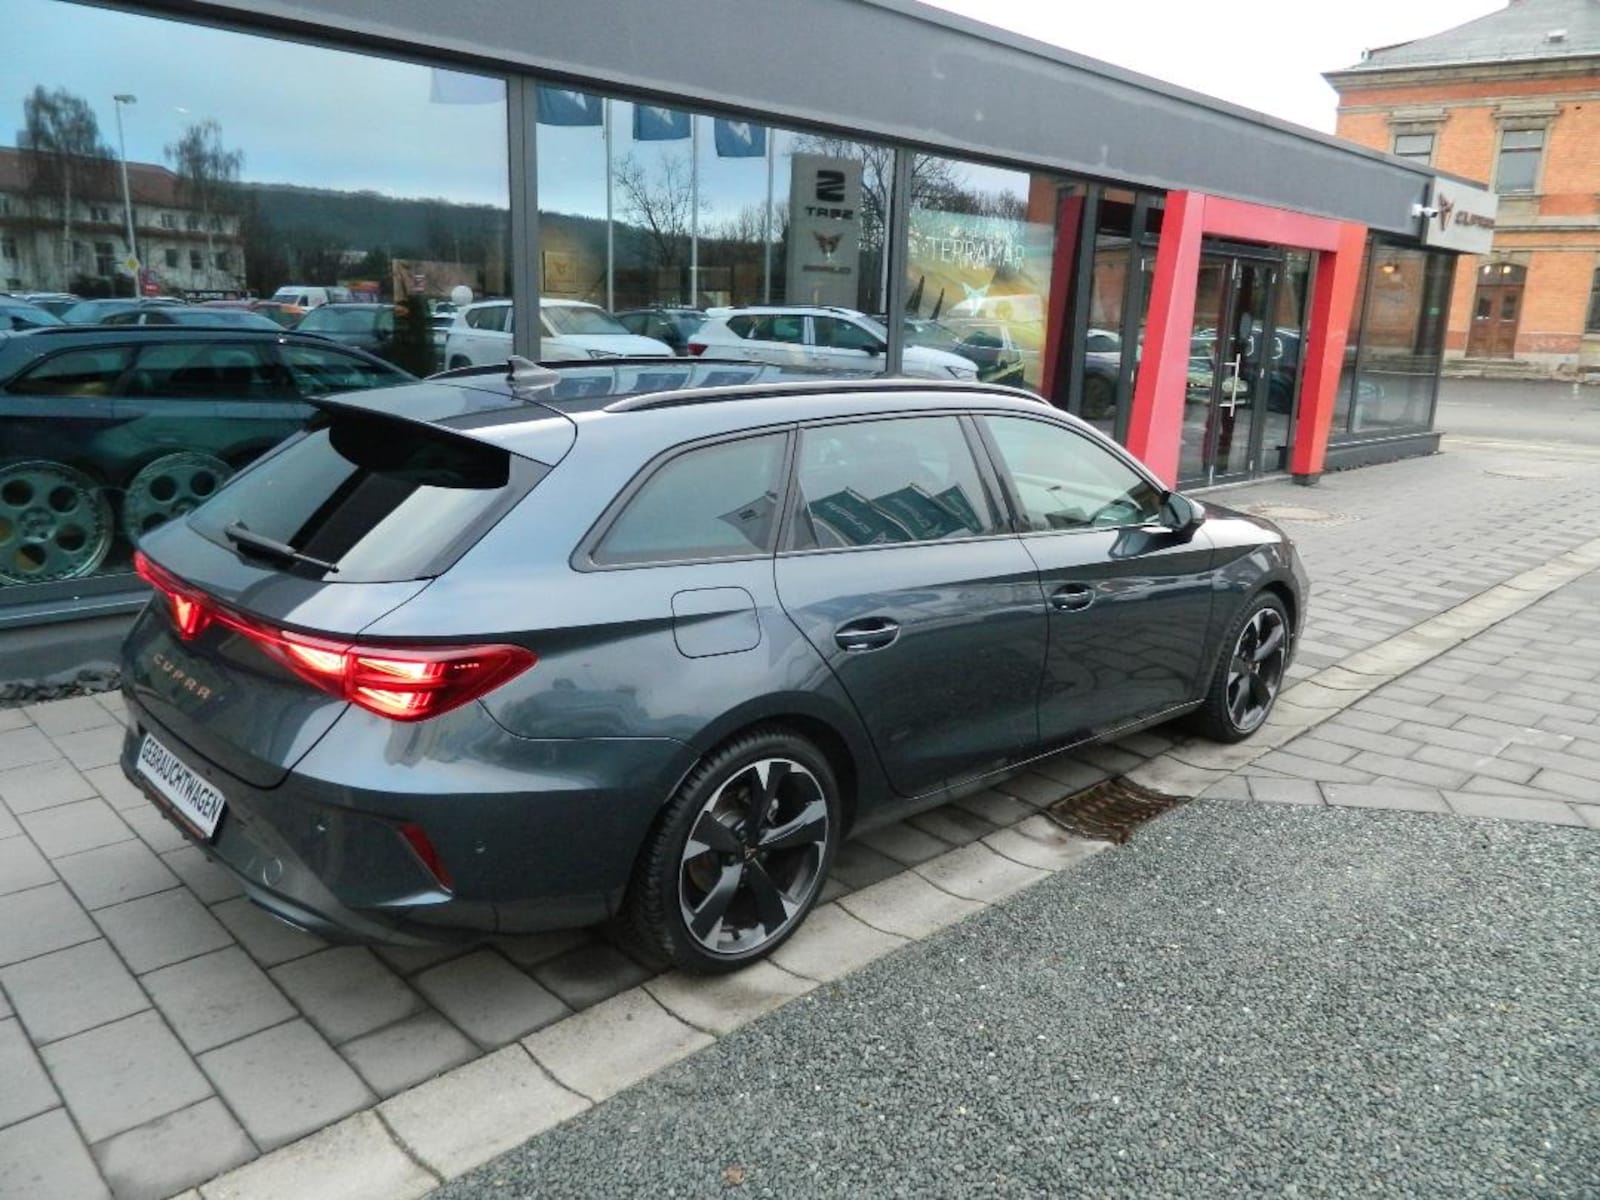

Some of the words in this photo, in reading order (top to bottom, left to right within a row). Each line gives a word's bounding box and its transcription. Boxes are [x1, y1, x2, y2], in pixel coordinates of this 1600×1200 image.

[926, 236, 1025, 271] TERRAMAR
[154, 654, 212, 699] CUPRA
[142, 738, 222, 822] GEBRAUCHTWAGEN
